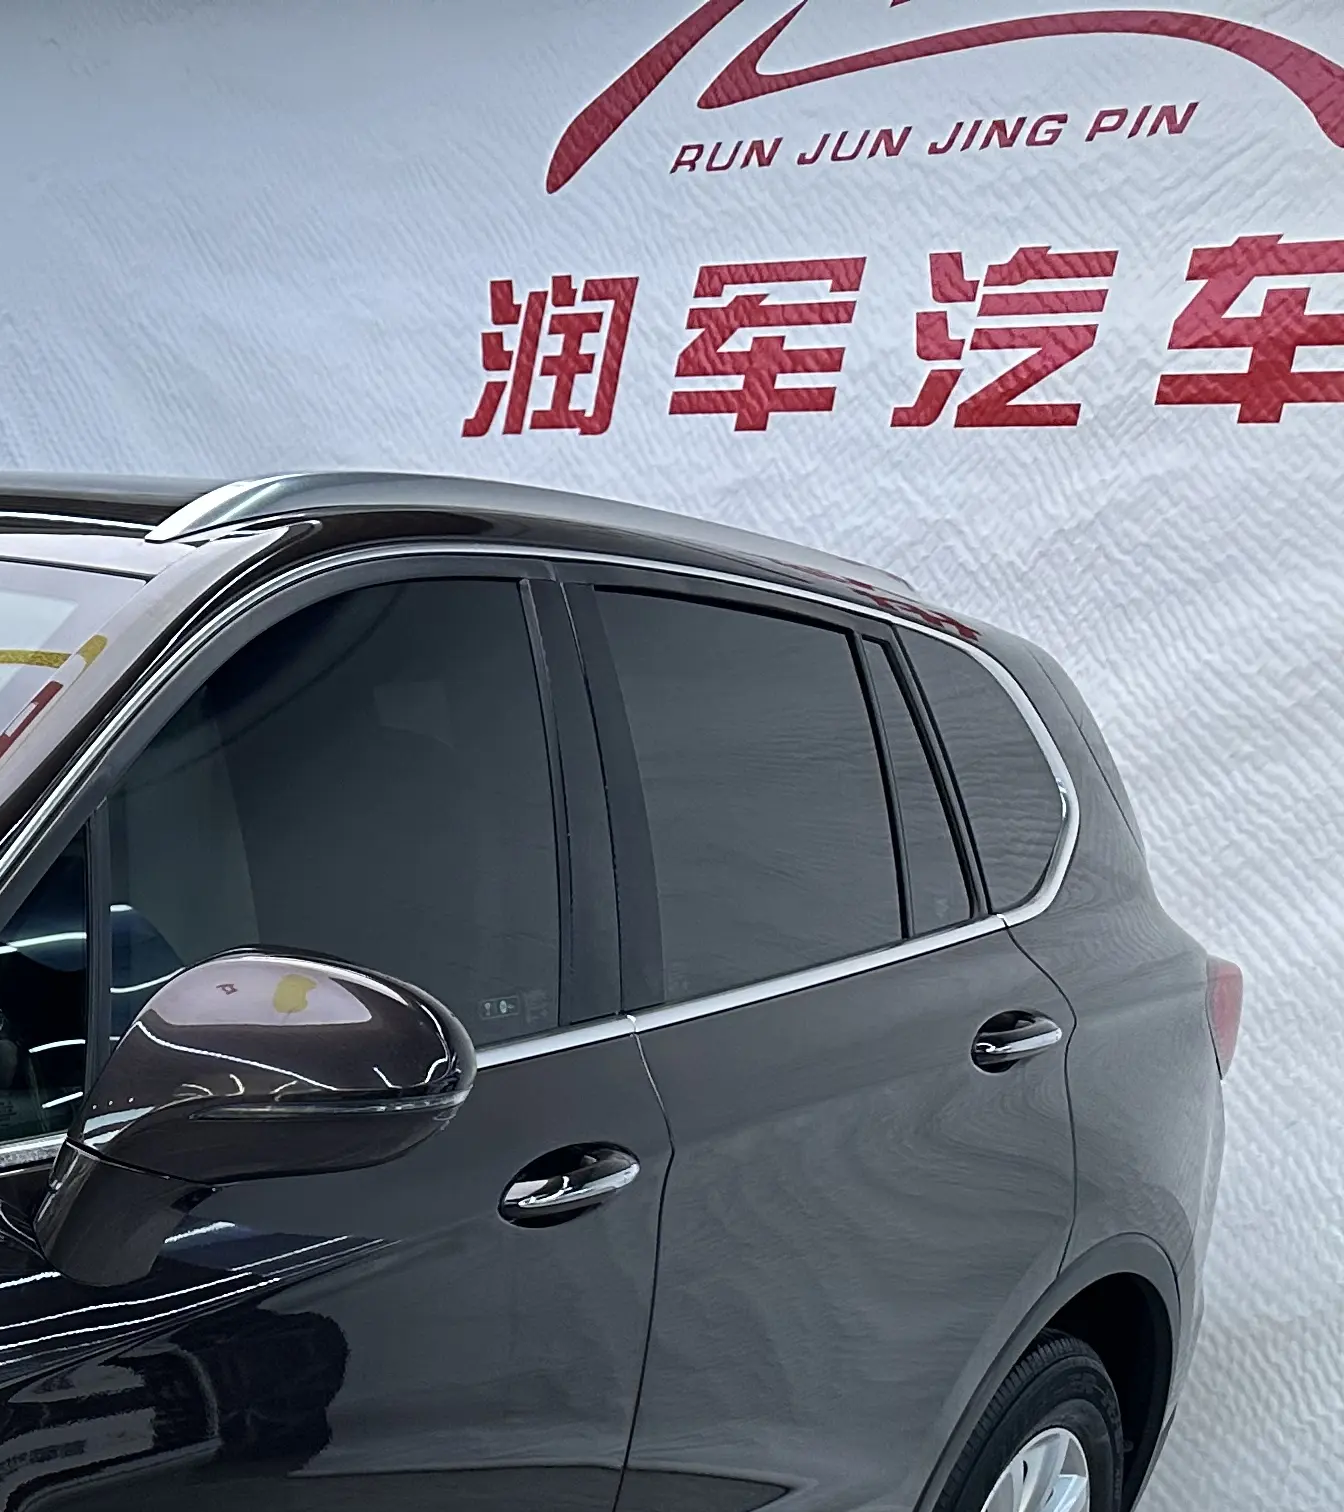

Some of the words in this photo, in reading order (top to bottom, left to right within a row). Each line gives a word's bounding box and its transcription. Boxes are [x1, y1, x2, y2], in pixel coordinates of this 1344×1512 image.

[669, 136, 784, 174] RUN
[797, 125, 913, 165] JUN
[927, 113, 1068, 155] JING
[1084, 101, 1200, 142] PIN
[461, 233, 1344, 437] 润军汽车
